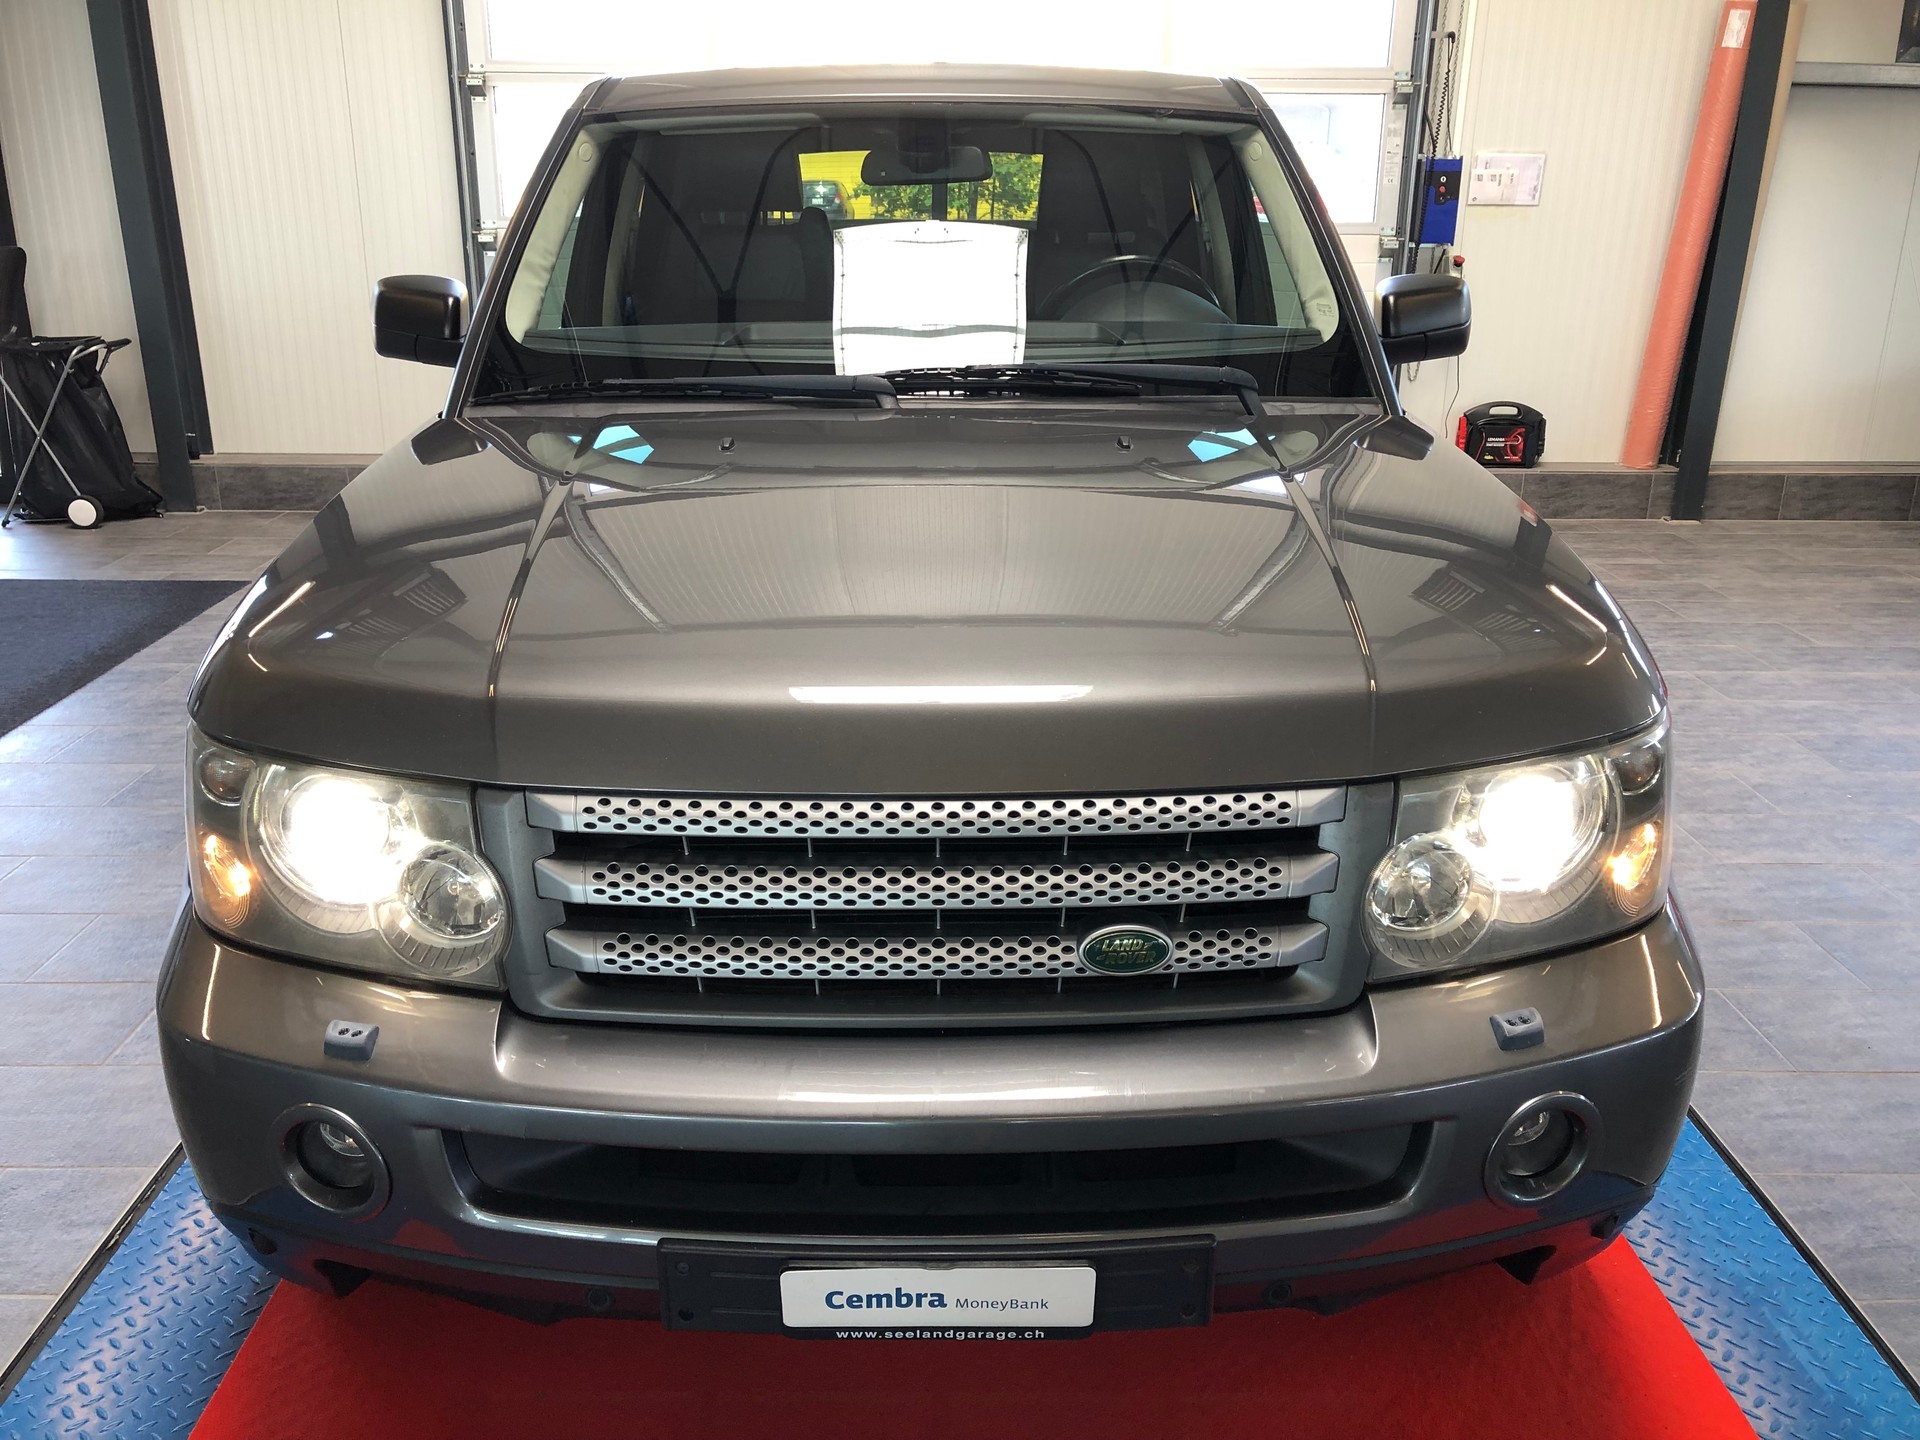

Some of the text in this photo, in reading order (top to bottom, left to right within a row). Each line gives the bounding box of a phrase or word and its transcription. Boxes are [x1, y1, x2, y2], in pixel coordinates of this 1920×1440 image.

[1102, 939, 1144, 951] LAND
[1105, 951, 1156, 964] ROVER
[824, 1287, 1049, 1311] Cembra MoneyBank
[836, 1329, 1045, 1341] www.seelandgarage.ch
